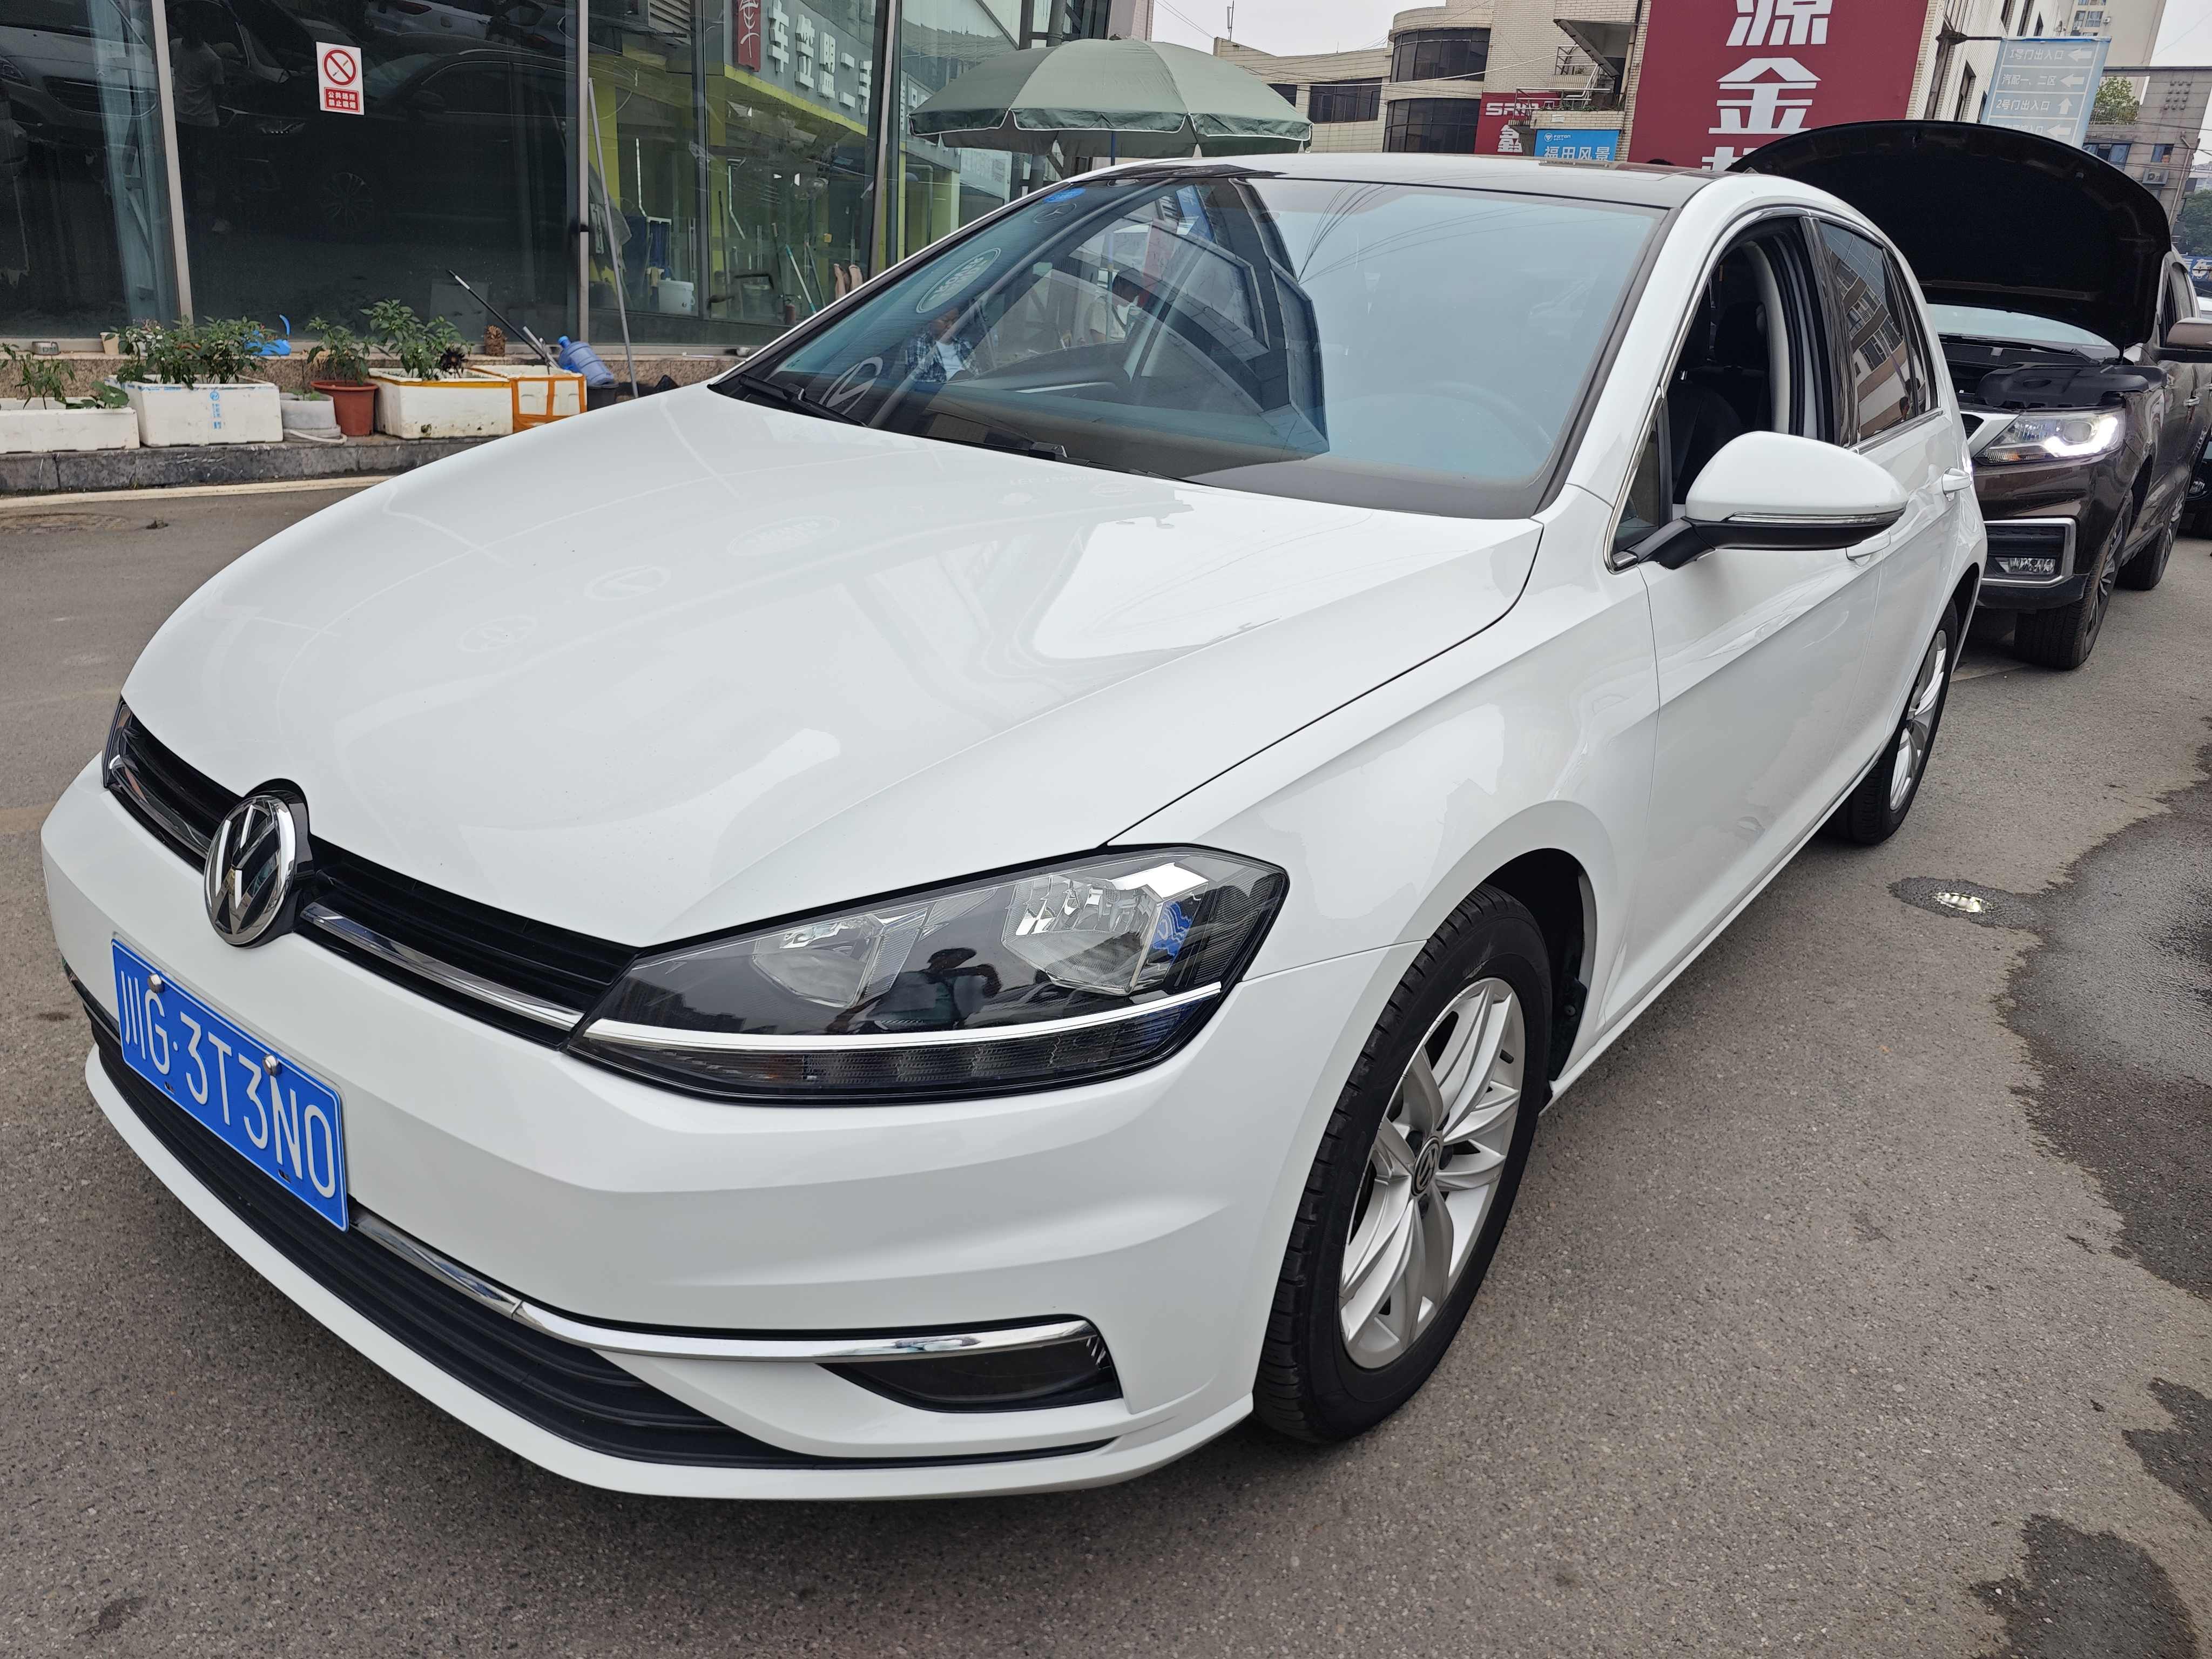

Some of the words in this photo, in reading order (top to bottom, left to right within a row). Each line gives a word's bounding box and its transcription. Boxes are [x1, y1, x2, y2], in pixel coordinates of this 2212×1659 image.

[2009, 49, 2064, 60] 1号门出入口
[2001, 74, 2056, 86] 汽配一、二区
[1996, 99, 2050, 111] 2号门出入口
[1544, 145, 1610, 161] 福田风景
